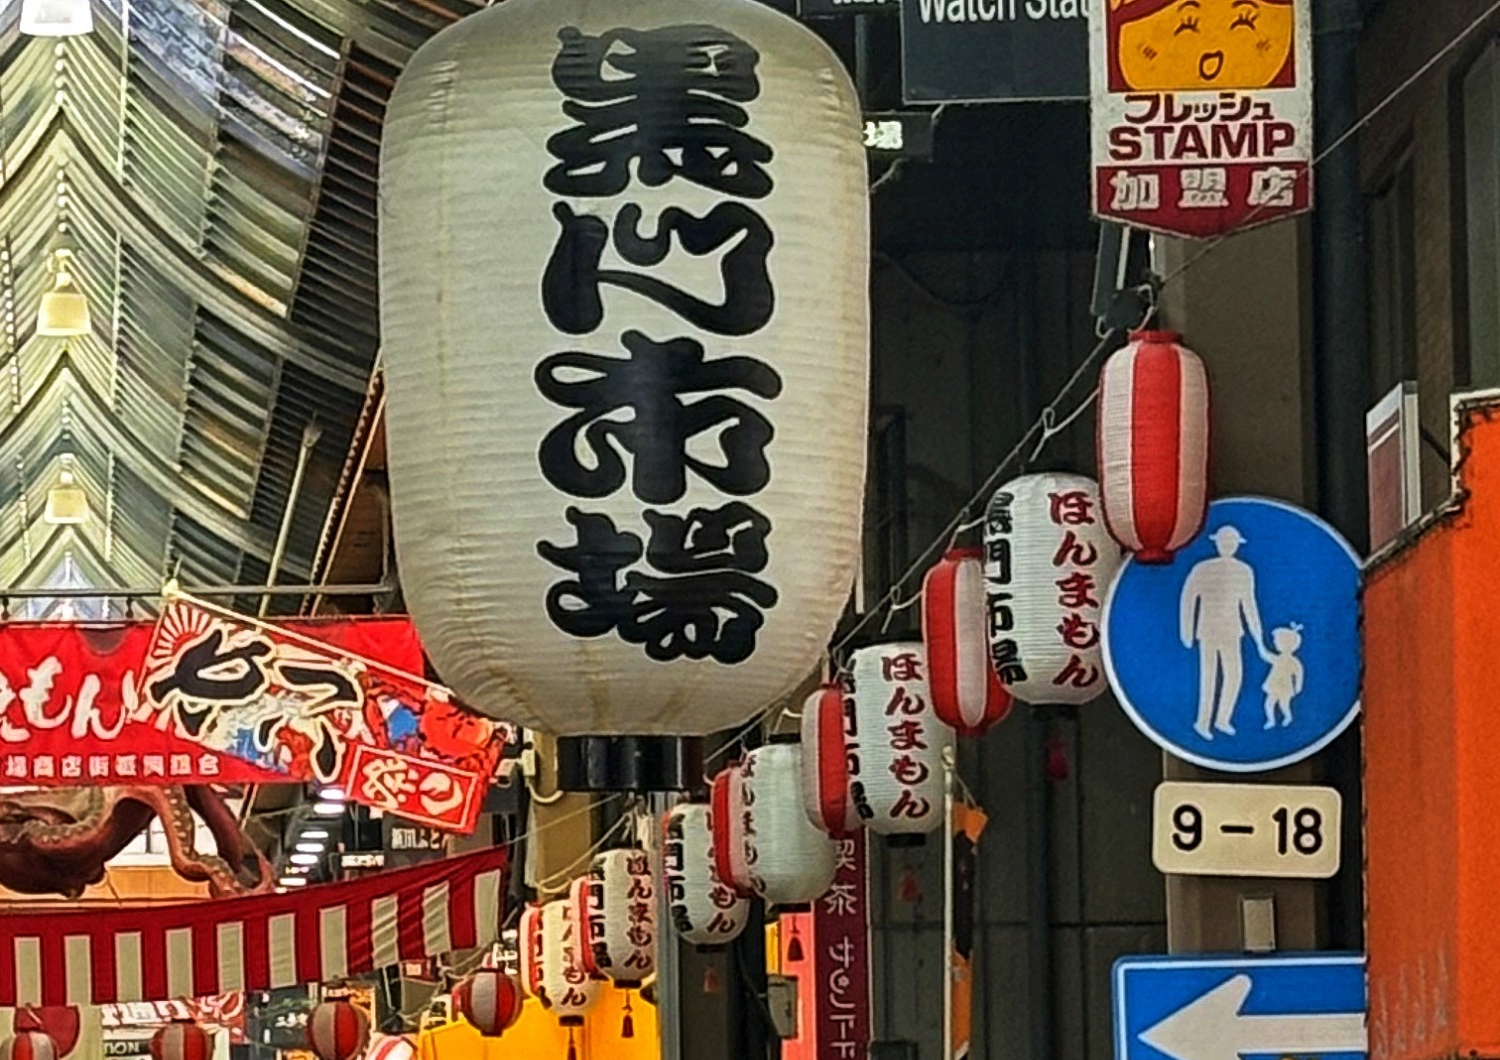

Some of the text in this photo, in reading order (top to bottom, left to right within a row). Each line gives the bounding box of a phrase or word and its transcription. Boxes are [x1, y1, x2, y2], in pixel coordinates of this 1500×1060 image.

[1108, 122, 1296, 161] STAMP
[1124, 93, 1275, 123] フレッシュ
[1109, 166, 1298, 210] 加盟店
[1047, 490, 1102, 690] ほんまもん
[881, 652, 931, 820] ほんまもん
[625, 854, 653, 970] ほんまもん
